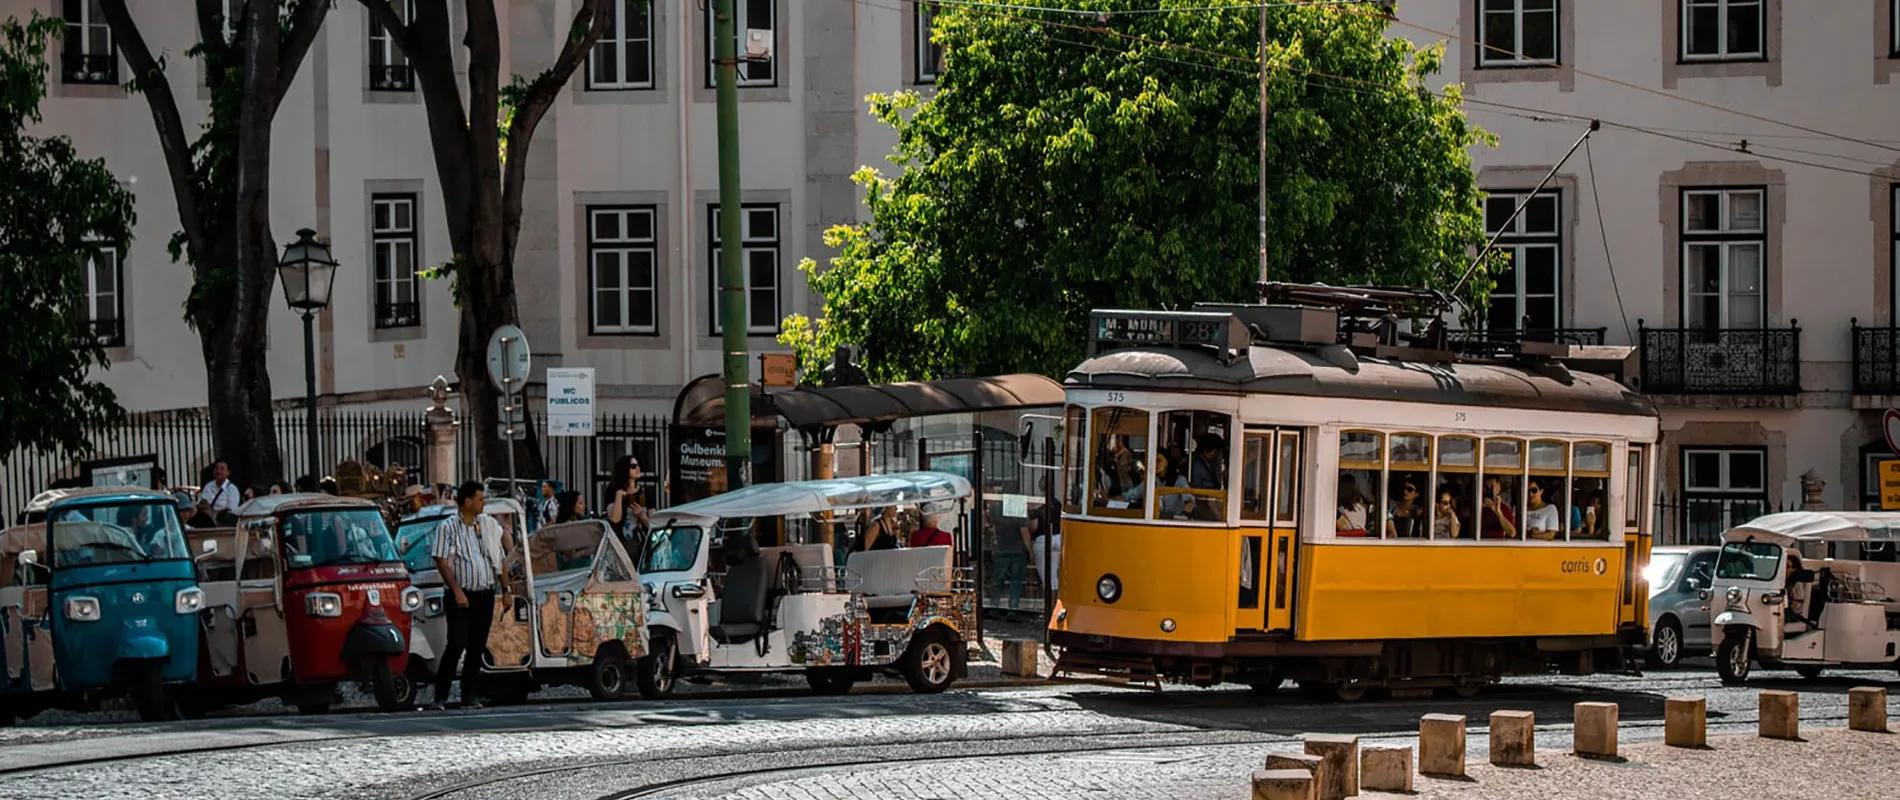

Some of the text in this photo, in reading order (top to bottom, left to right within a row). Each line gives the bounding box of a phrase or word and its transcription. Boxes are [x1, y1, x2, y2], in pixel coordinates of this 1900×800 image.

[563, 387, 576, 395] WC
[1107, 392, 1125, 402] 575
[1455, 412, 1466, 422] 575
[680, 443, 726, 456] Gulbenki
[1561, 556, 1590, 574] carris
